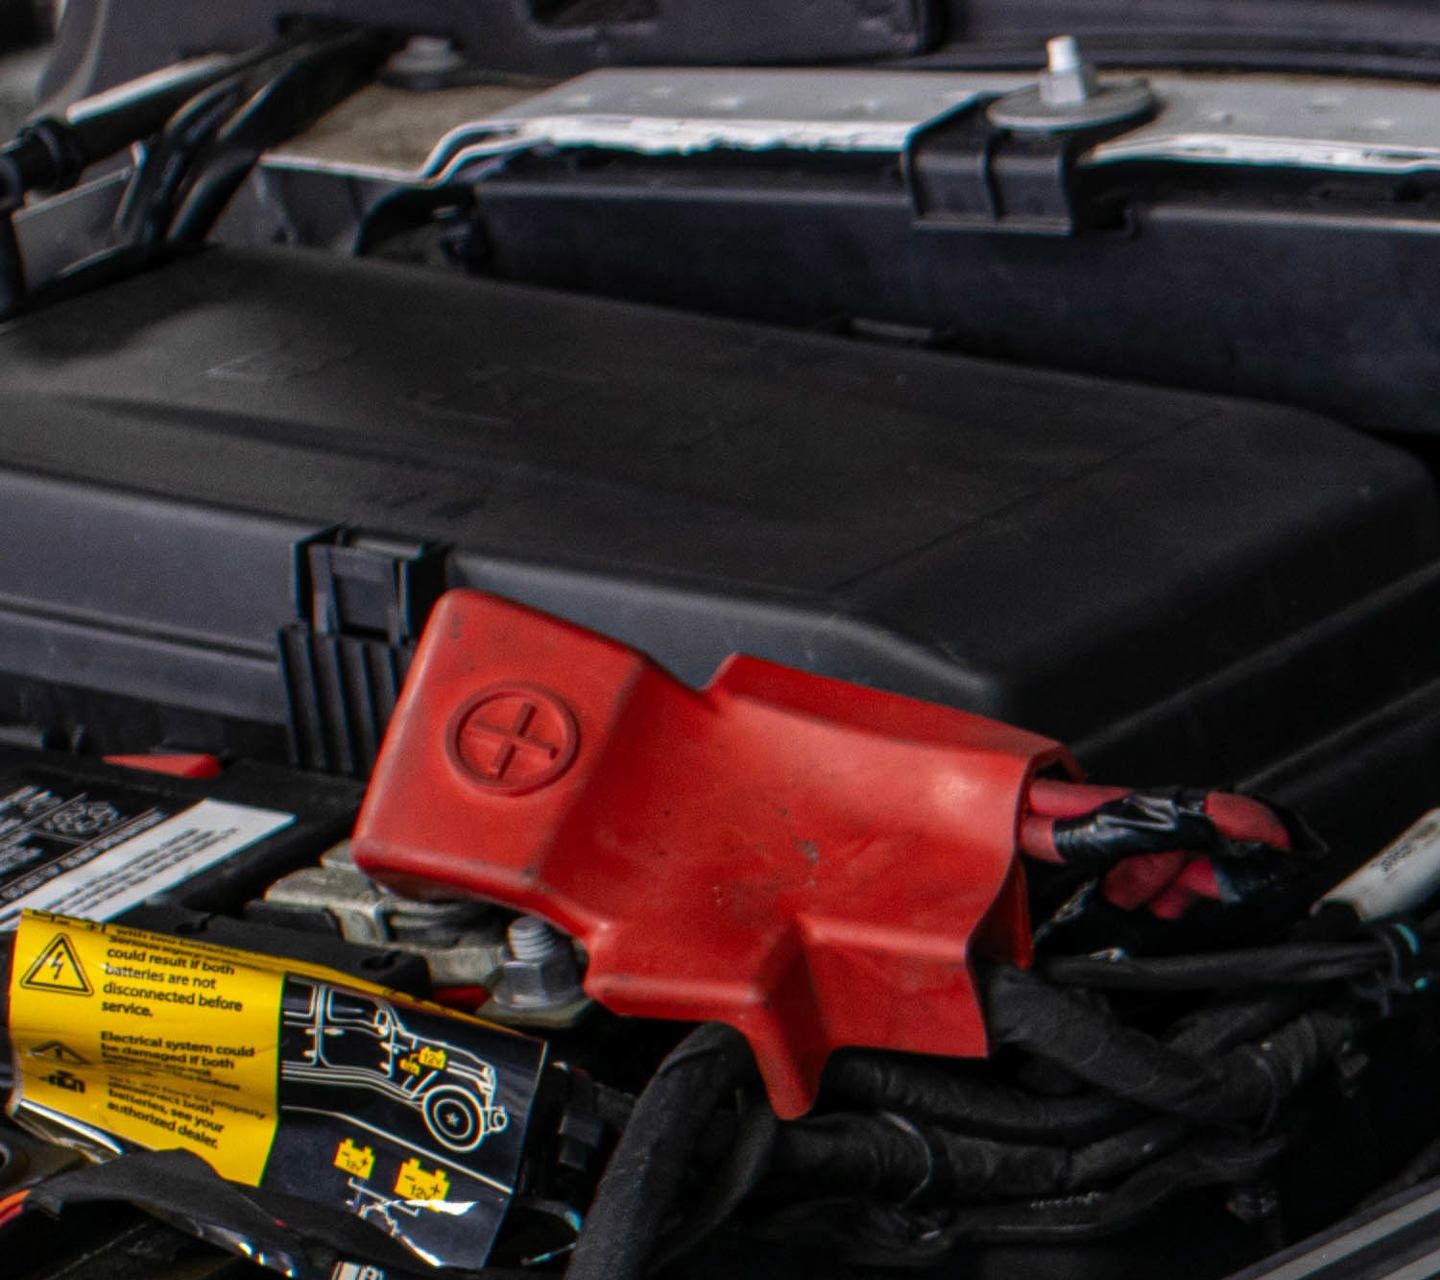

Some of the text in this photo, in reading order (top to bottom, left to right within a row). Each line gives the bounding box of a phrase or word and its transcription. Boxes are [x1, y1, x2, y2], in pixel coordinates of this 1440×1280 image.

[107, 948, 146, 962] could
[149, 954, 186, 968] result
[190, 957, 198, 969] if
[202, 961, 235, 975] both
[105, 963, 216, 989] batteries are not
[101, 1000, 154, 1017] service.
[103, 983, 243, 1012] disconnected before
[101, 1031, 255, 1057] Electrical system could
[202, 1056, 235, 1069] both
[195, 1115, 224, 1133] your
